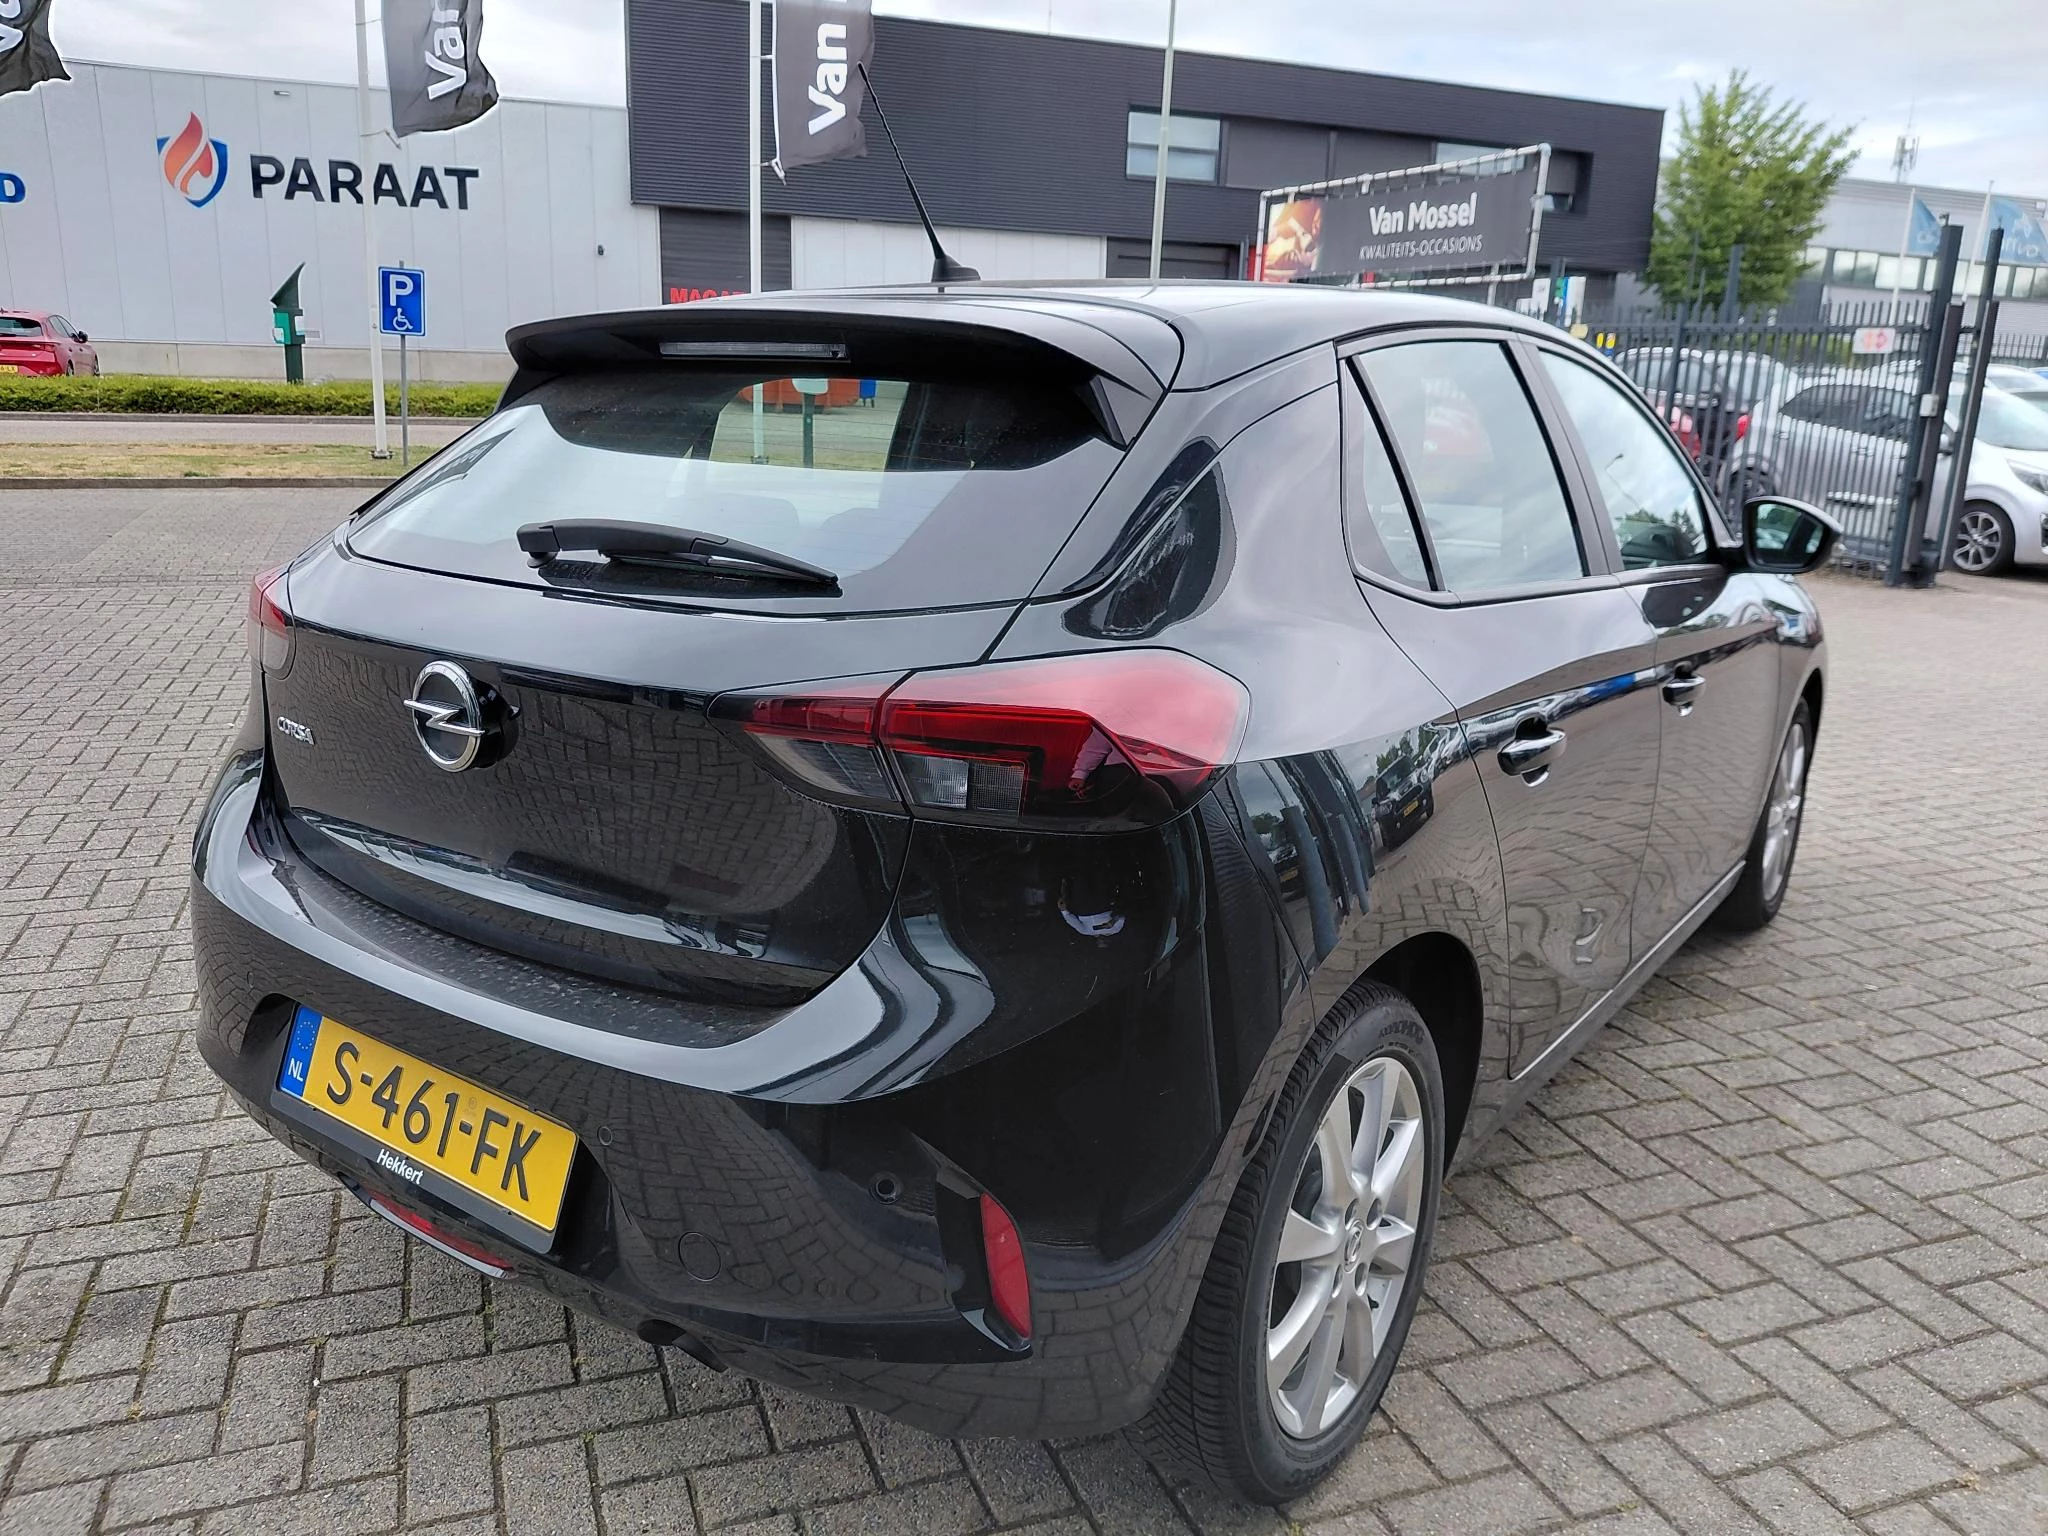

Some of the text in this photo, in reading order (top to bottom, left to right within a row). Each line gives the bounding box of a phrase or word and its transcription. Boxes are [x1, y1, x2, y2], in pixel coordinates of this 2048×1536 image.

[808, 23, 848, 136] Van
[250, 154, 479, 210] PARAAT
[1369, 191, 1478, 235] Van Mossel
[1359, 234, 1483, 260] KWALITEITS-OCCASIONS
[390, 274, 414, 307] P
[277, 716, 315, 746] CORSA
[288, 1057, 304, 1082] NL
[326, 1041, 542, 1202] S-461-FK
[376, 1149, 424, 1185] Hekkert
